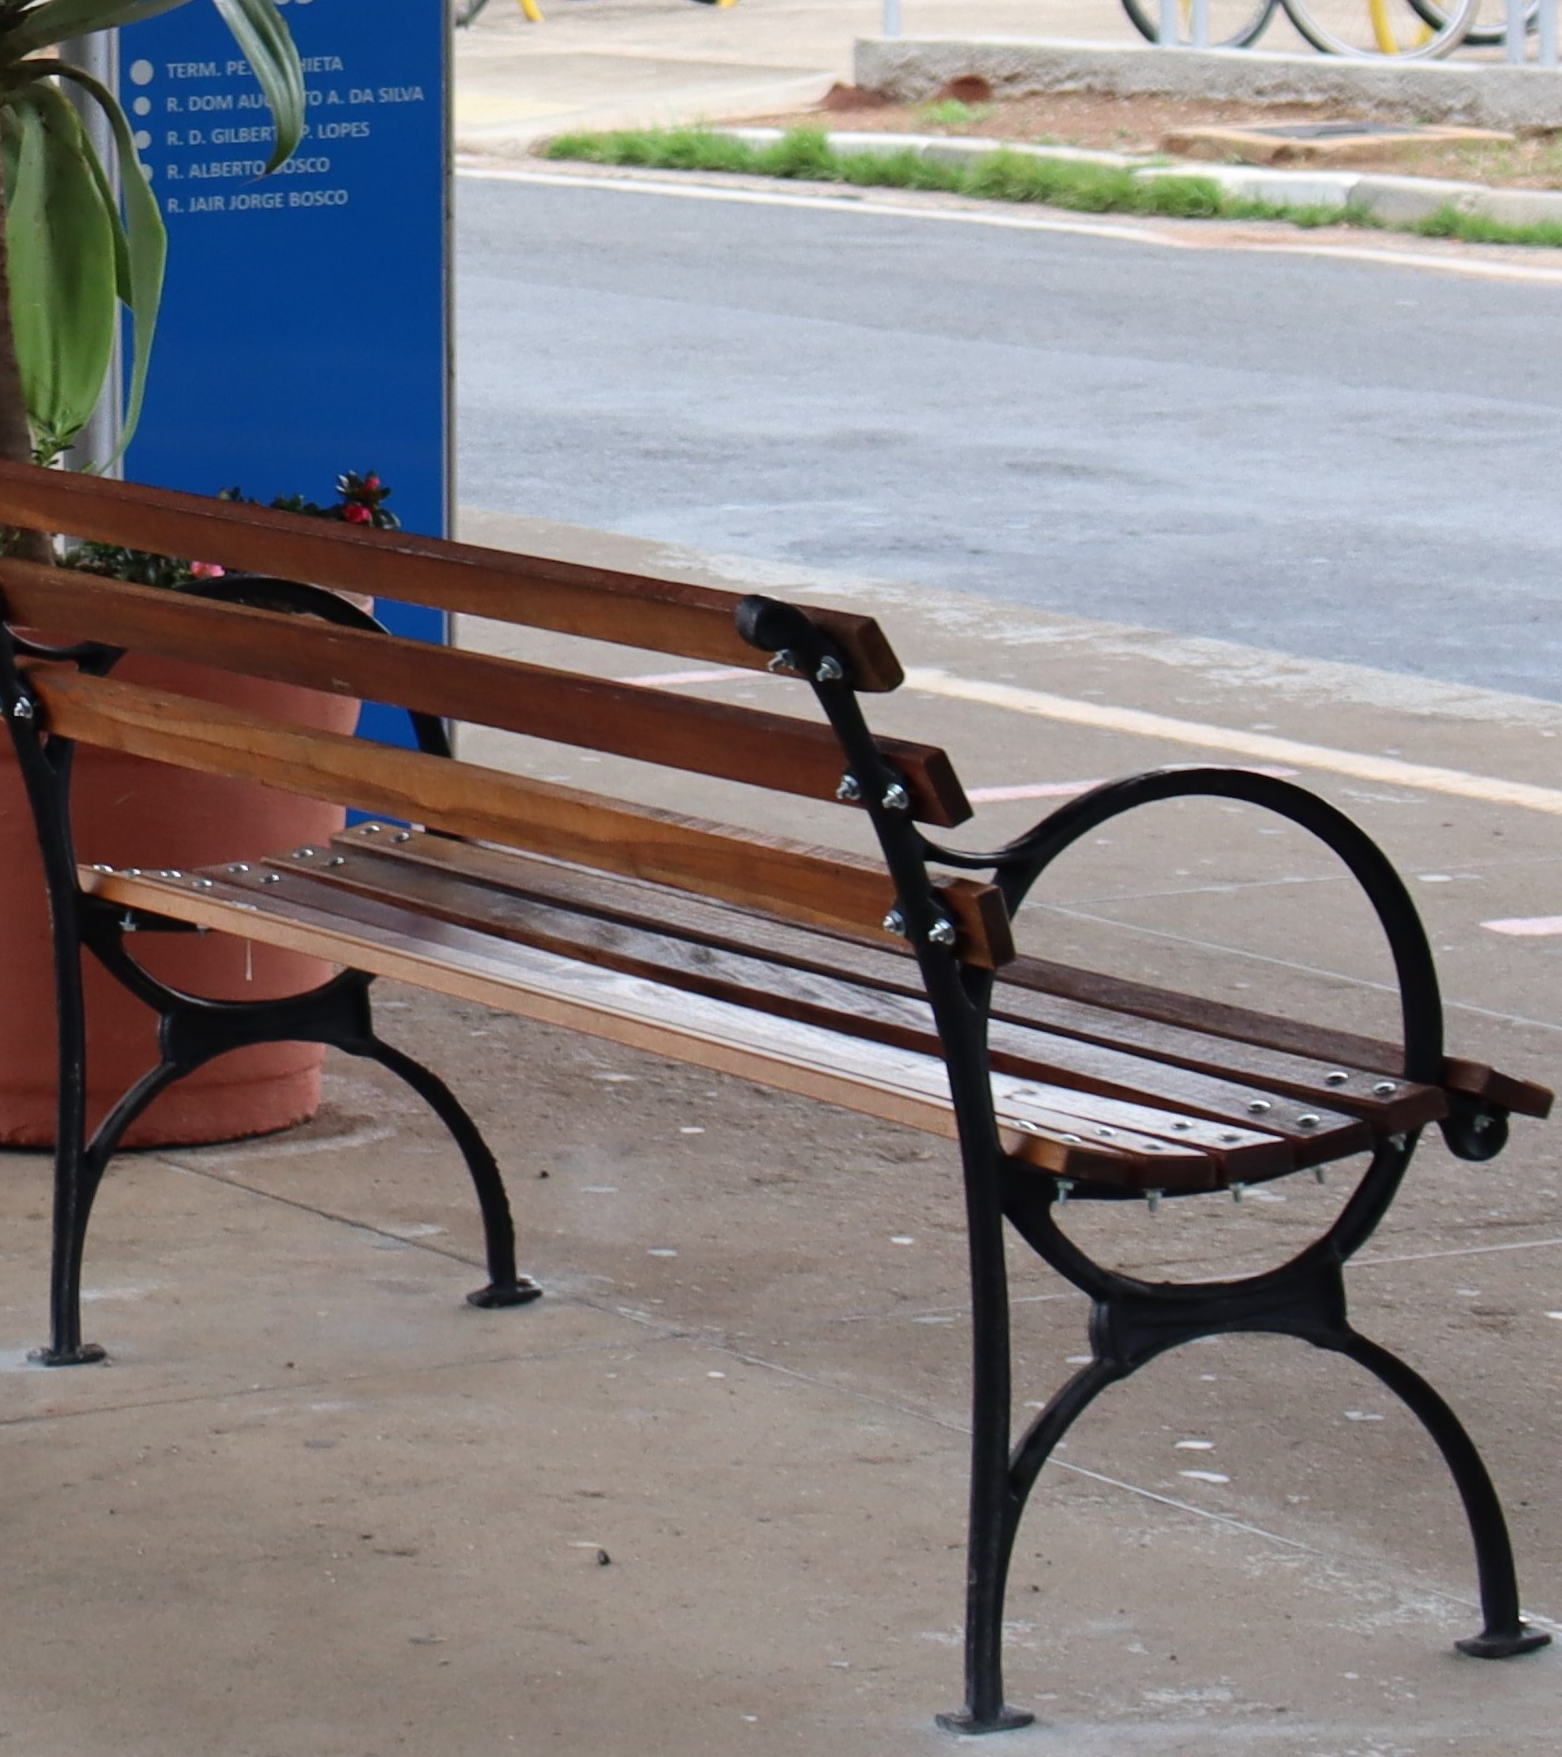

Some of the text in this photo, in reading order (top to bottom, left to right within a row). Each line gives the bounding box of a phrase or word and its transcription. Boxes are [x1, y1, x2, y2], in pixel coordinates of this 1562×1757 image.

[167, 62, 220, 78] TERM.
[226, 61, 252, 75] PE.
[167, 97, 183, 112] R.
[189, 95, 233, 111] DOM
[327, 90, 344, 104] A.
[350, 87, 374, 105] DA
[379, 86, 424, 103] SILVA
[167, 131, 184, 146] R.
[189, 130, 206, 145] D.
[318, 122, 370, 139] LOPES
[167, 165, 184, 179] R.
[189, 160, 266, 178] ALBERTO
[167, 190, 348, 213] R. JAIR JORGE BOSCO
